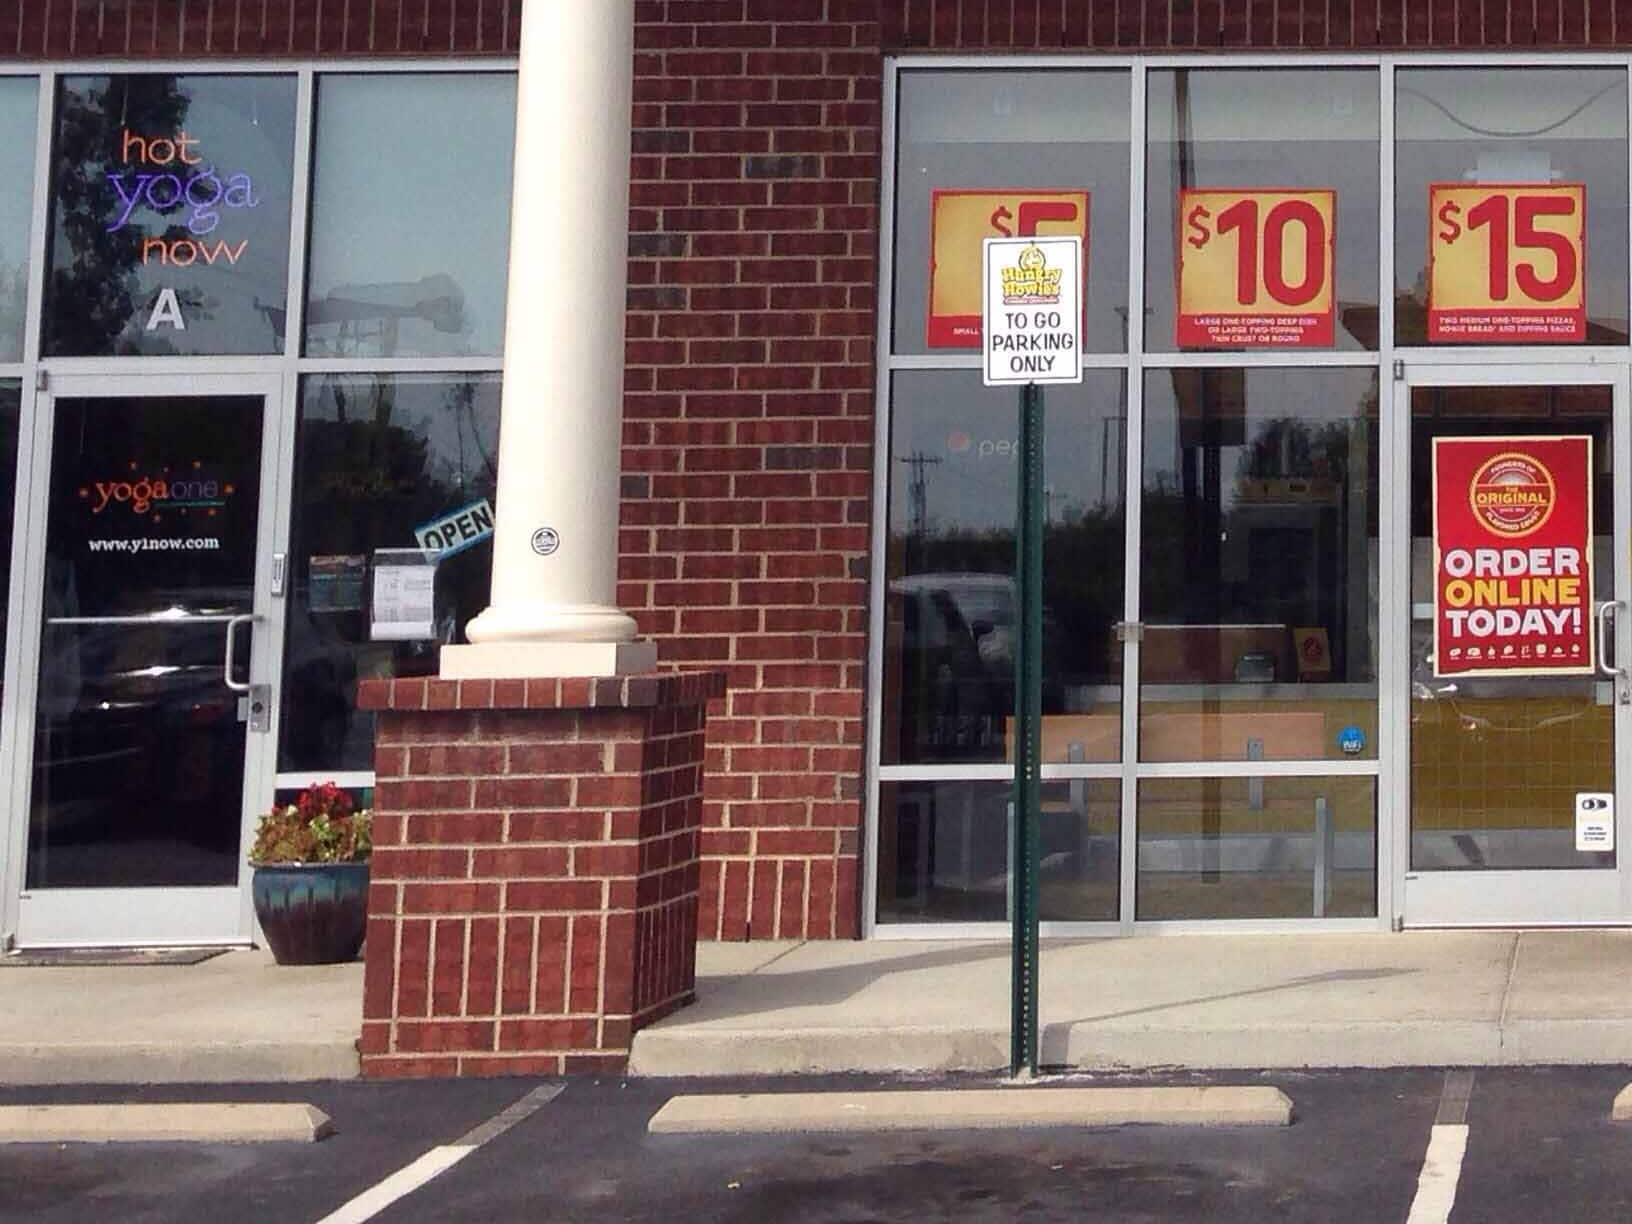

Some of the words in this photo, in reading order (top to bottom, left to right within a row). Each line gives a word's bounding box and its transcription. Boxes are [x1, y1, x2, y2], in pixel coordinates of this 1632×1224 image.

[122, 129, 202, 165] hot
[106, 165, 259, 234] yoga
[143, 239, 248, 266] now
[1188, 199, 1326, 306] $10
[1438, 194, 1577, 302] $15
[146, 287, 185, 330] A
[1005, 312, 1028, 329] TO
[1034, 311, 1061, 329] GO
[992, 333, 1073, 351] PARKING
[1010, 355, 1056, 373] ONLY
[1476, 492, 1547, 505] ORIGINAL
[423, 505, 494, 549] OPEN
[1445, 547, 1580, 577] ORDER
[1445, 577, 1581, 607] ONLINE
[1445, 607, 1581, 637] TODAY!
